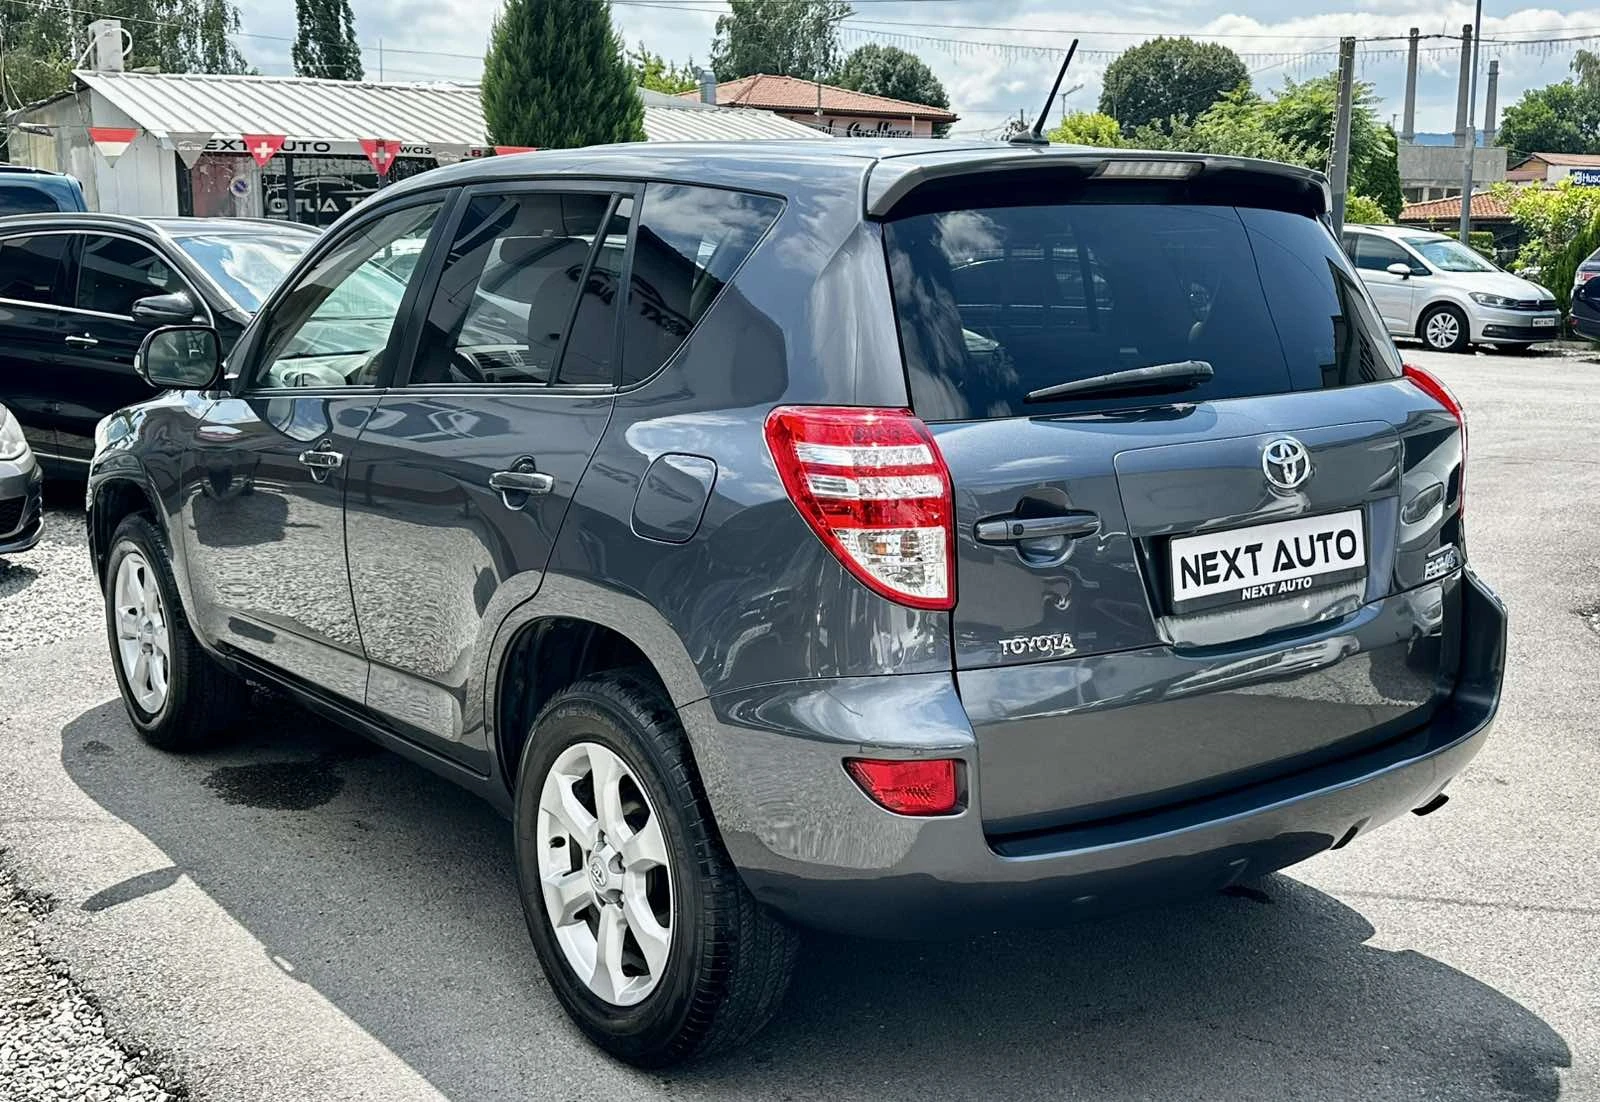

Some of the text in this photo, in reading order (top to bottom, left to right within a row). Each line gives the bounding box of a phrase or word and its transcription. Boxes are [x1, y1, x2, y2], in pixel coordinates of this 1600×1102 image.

[204, 138, 248, 151] EXT
[278, 141, 331, 152] UTO
[1180, 528, 1357, 589] NEXT AUTO
[1242, 576, 1312, 600] NEXT AUTO
[998, 633, 1074, 656] TOYOTA
